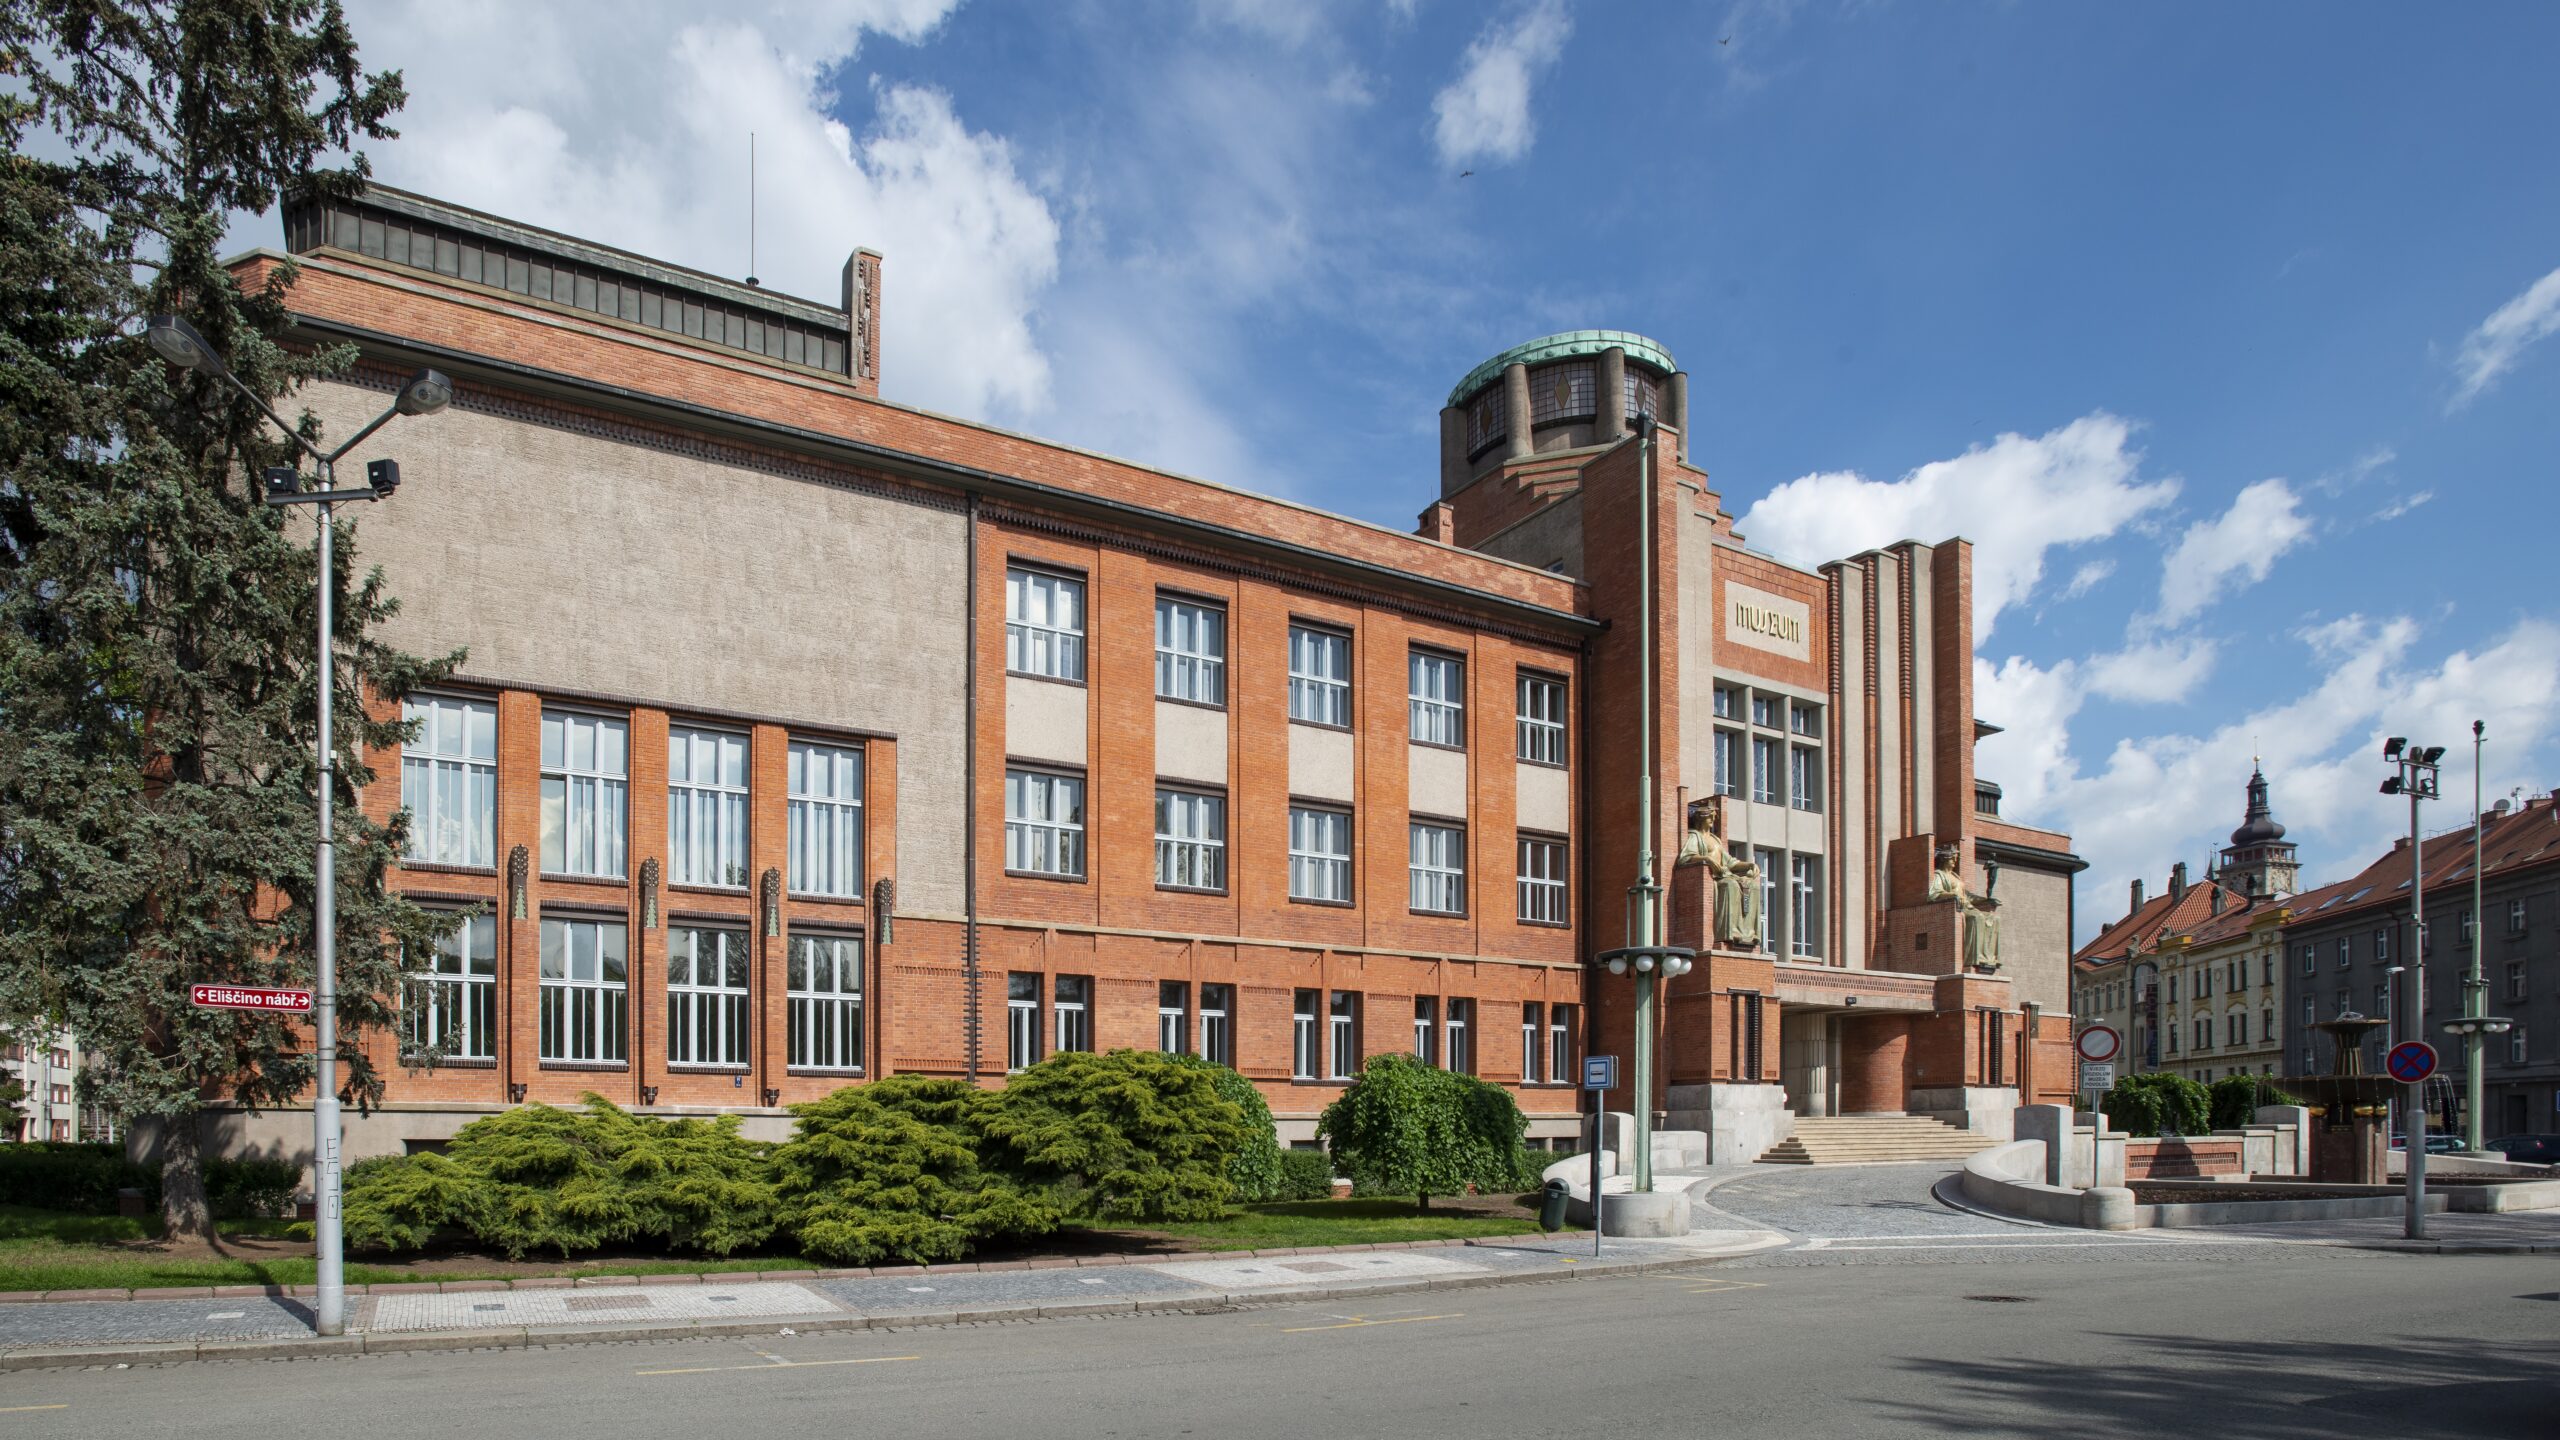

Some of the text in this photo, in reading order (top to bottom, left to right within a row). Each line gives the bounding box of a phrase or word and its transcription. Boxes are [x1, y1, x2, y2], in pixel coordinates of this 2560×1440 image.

[1736, 601, 1801, 643] MUSEUM
[207, 988, 299, 1007] Eliščino nábř.
